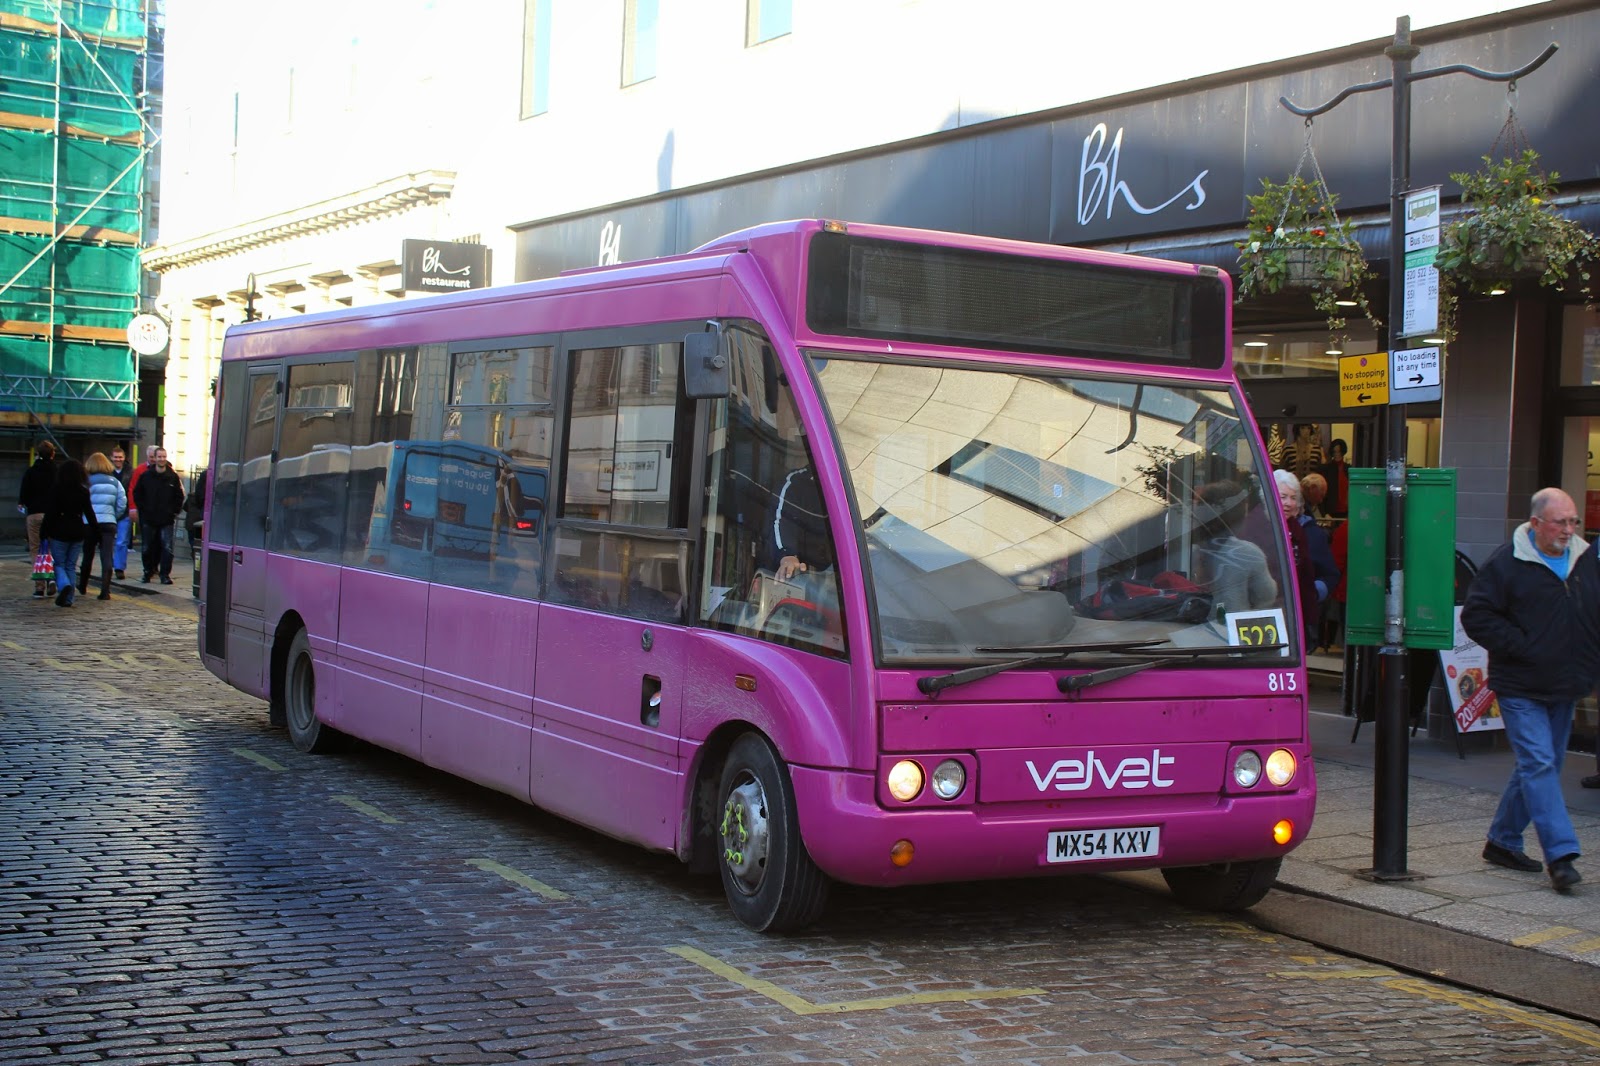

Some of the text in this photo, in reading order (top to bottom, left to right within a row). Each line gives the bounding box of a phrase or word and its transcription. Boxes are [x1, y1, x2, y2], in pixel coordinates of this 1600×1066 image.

[1077, 122, 1209, 226] Bhs
[598, 220, 622, 267] Bh
[1409, 233, 1435, 246] Bus Stop
[422, 247, 471, 276] Bhs
[421, 277, 471, 289] restaurant
[1396, 364, 1404, 372] at
[1420, 361, 1437, 369] time
[1397, 351, 1437, 362] No loading
[1343, 369, 1385, 380] No stopping
[1341, 381, 1387, 392] except buses
[1238, 624, 1277, 646] 522
[1268, 672, 1297, 692] 813
[1025, 748, 1175, 792] velvet
[1056, 830, 1151, 857] MX54 KXV
